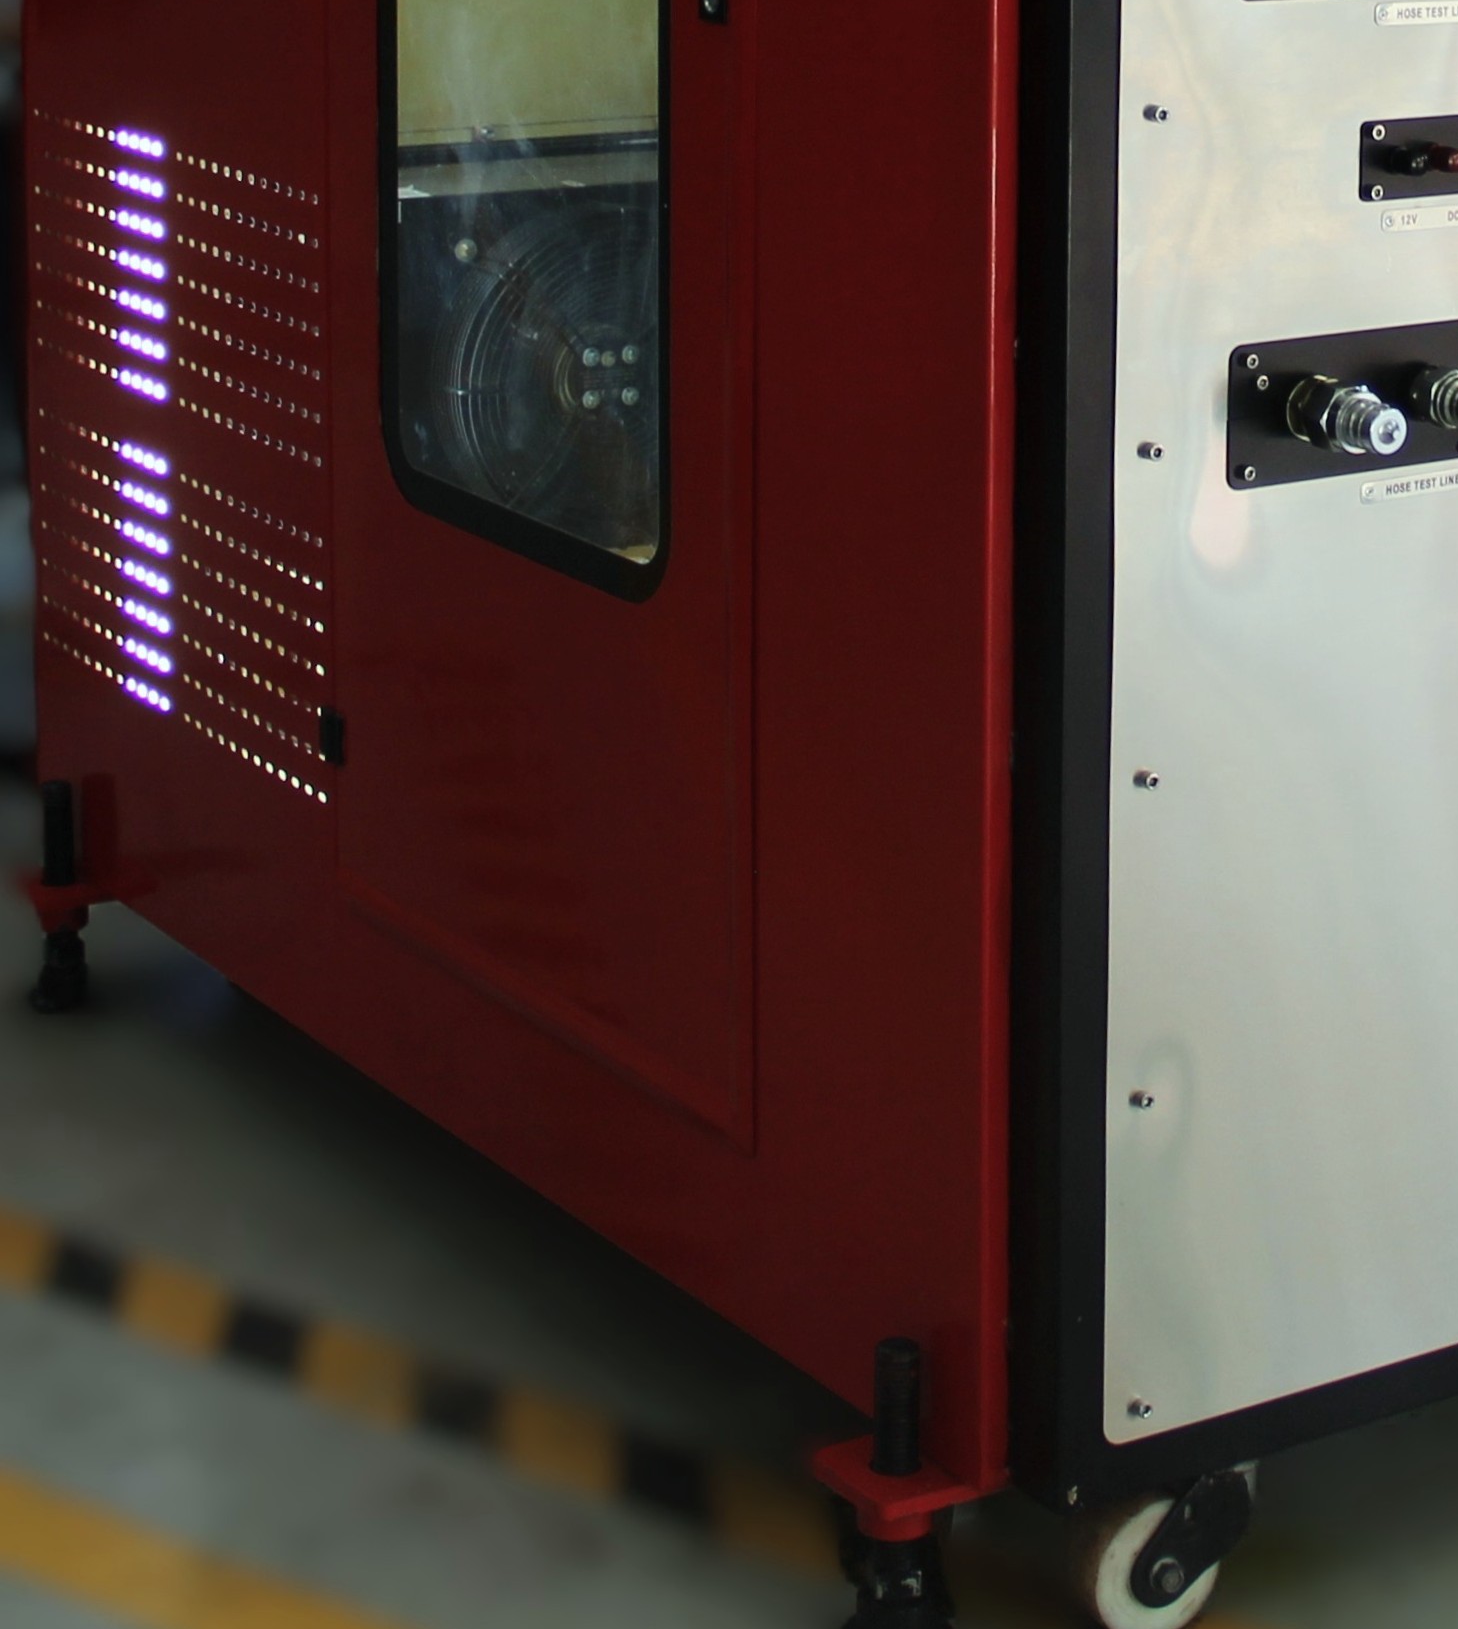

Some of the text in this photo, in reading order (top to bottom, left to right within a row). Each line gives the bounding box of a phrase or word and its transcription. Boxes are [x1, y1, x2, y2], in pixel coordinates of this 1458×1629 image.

[1397, 7, 1422, 20] HOSE
[1425, 6, 1448, 18] TEST
[1401, 214, 1417, 226] 12V
[1386, 482, 1412, 495] HOSE
[1414, 478, 1436, 491] TEST
